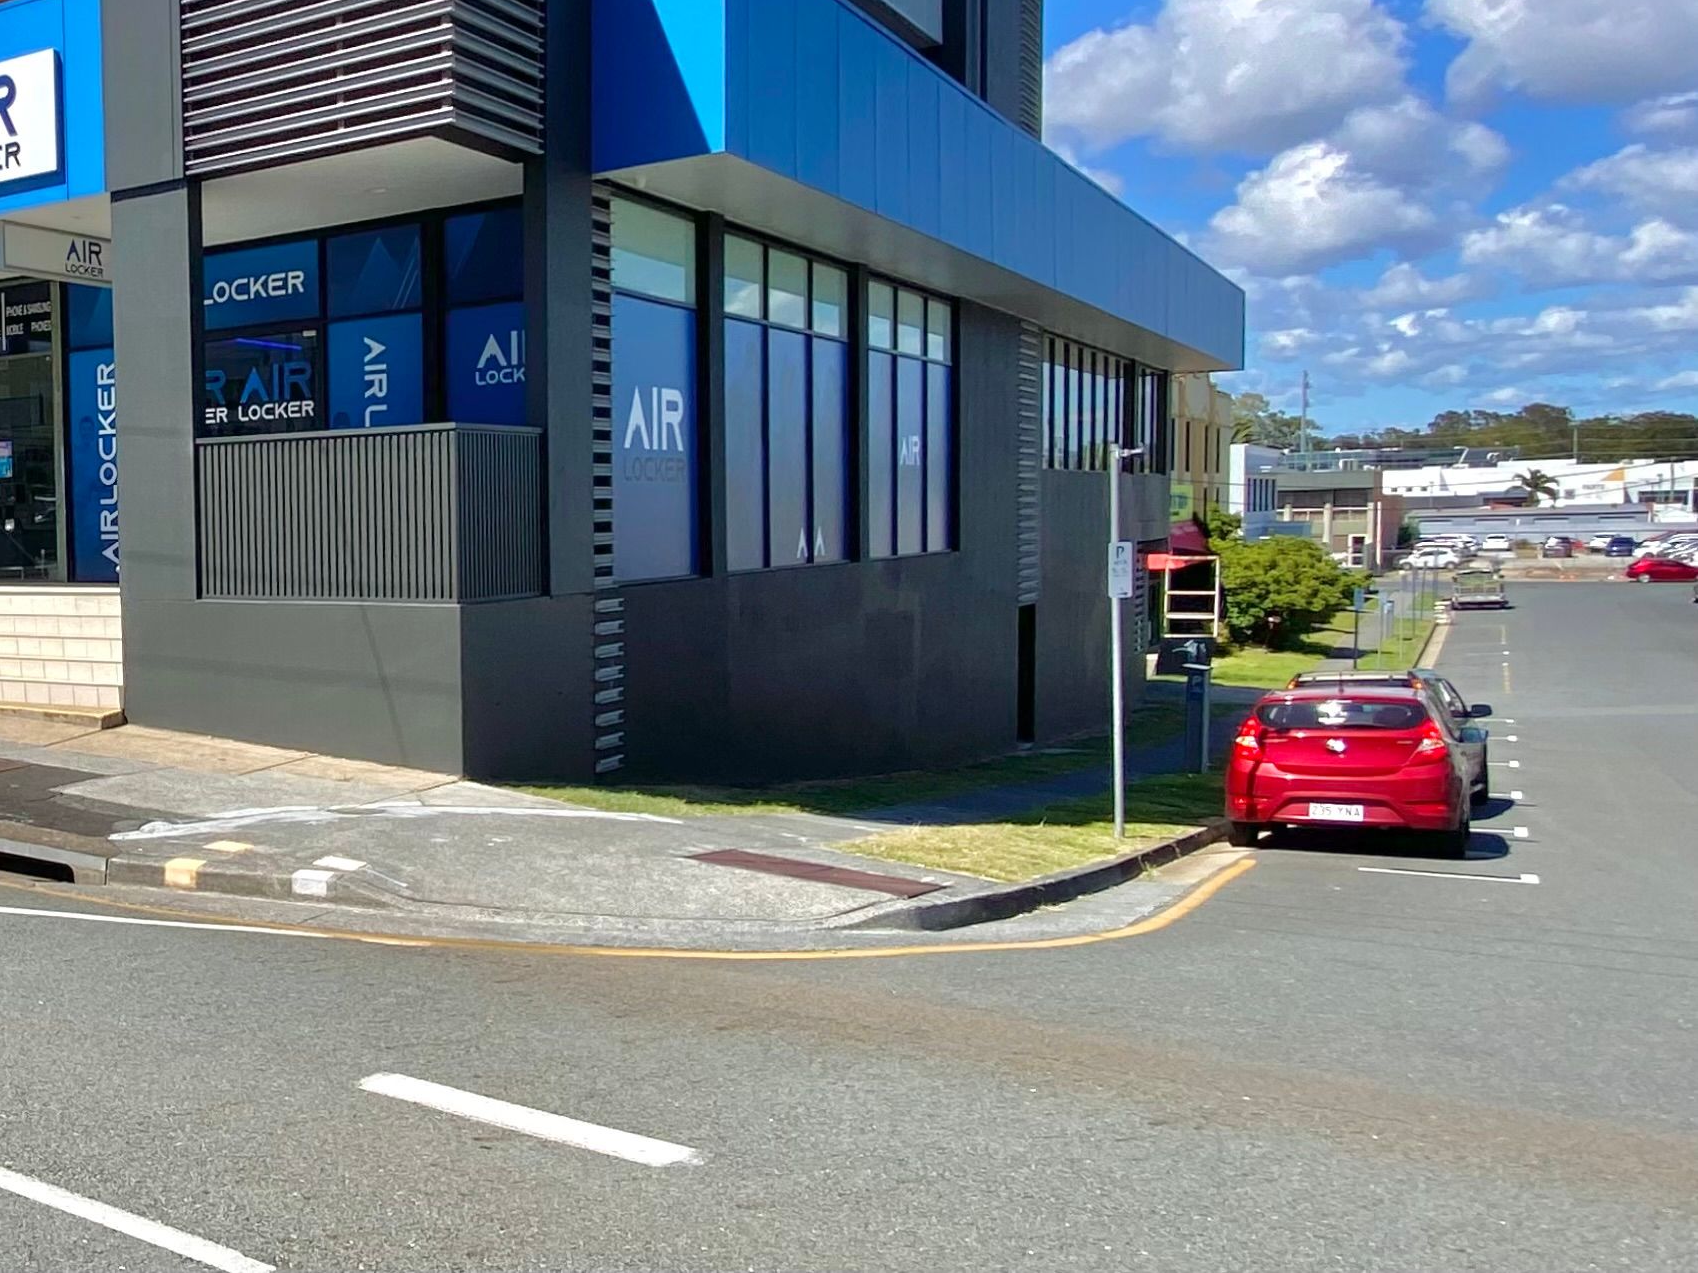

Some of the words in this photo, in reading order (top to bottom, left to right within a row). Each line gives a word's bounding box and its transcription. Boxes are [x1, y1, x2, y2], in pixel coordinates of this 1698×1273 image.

[67, 238, 102, 266] AIR
[65, 263, 104, 277] LOCKER
[477, 329, 525, 369] AI
[240, 361, 312, 404] AIR
[238, 400, 315, 422] LOCKER
[624, 385, 684, 451] AIR
[900, 436, 920, 466] AIR
[623, 456, 686, 483] LOCKER
[1117, 546, 1125, 558] P
